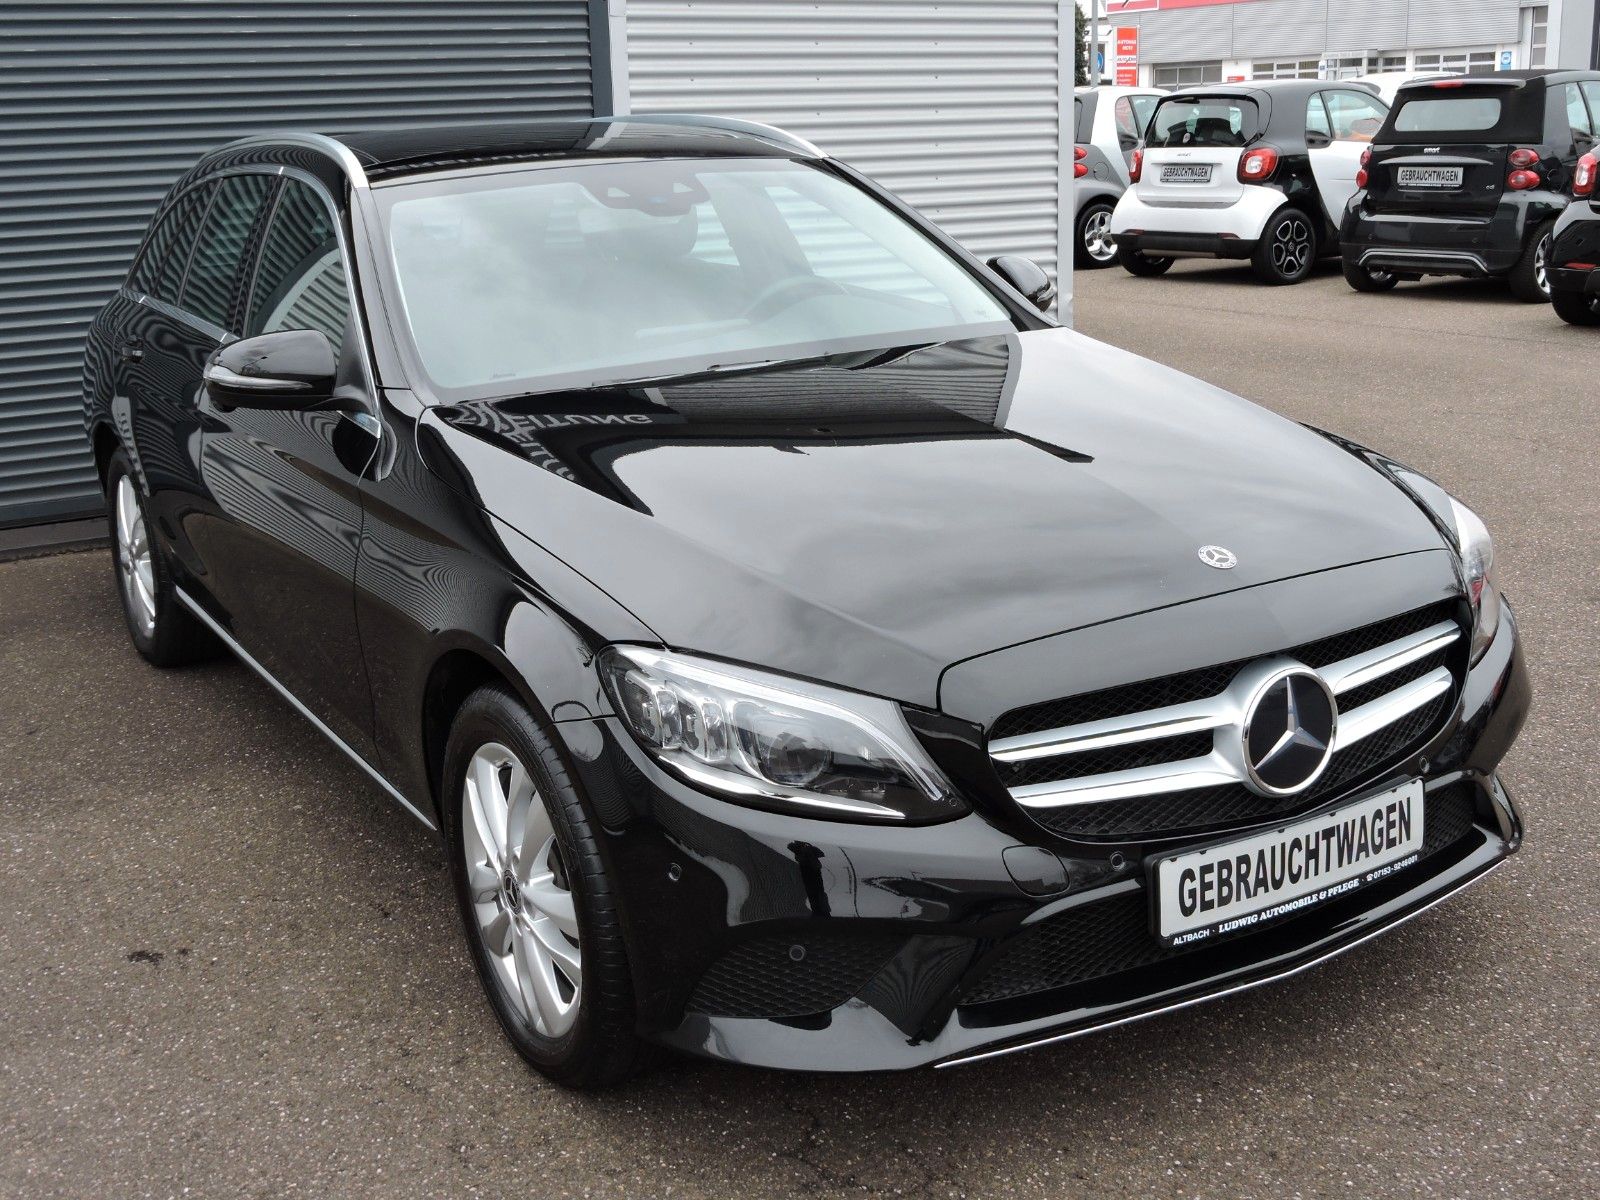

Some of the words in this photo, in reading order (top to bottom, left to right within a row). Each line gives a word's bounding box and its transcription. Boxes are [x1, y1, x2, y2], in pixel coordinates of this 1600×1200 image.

[1163, 167, 1209, 178] GEBRAUCHTWAGEN
[1400, 169, 1459, 182] GEBRAUCHTWAGEN
[1177, 796, 1412, 918] GEBRAUCHTWAGEN
[1173, 928, 1210, 946] ALTBACH
[1218, 914, 1259, 933] LUDWIG
[1259, 893, 1318, 921] AUTOMOBILE
[1318, 891, 1327, 900] &
[1327, 878, 1360, 898] PFLEGE
